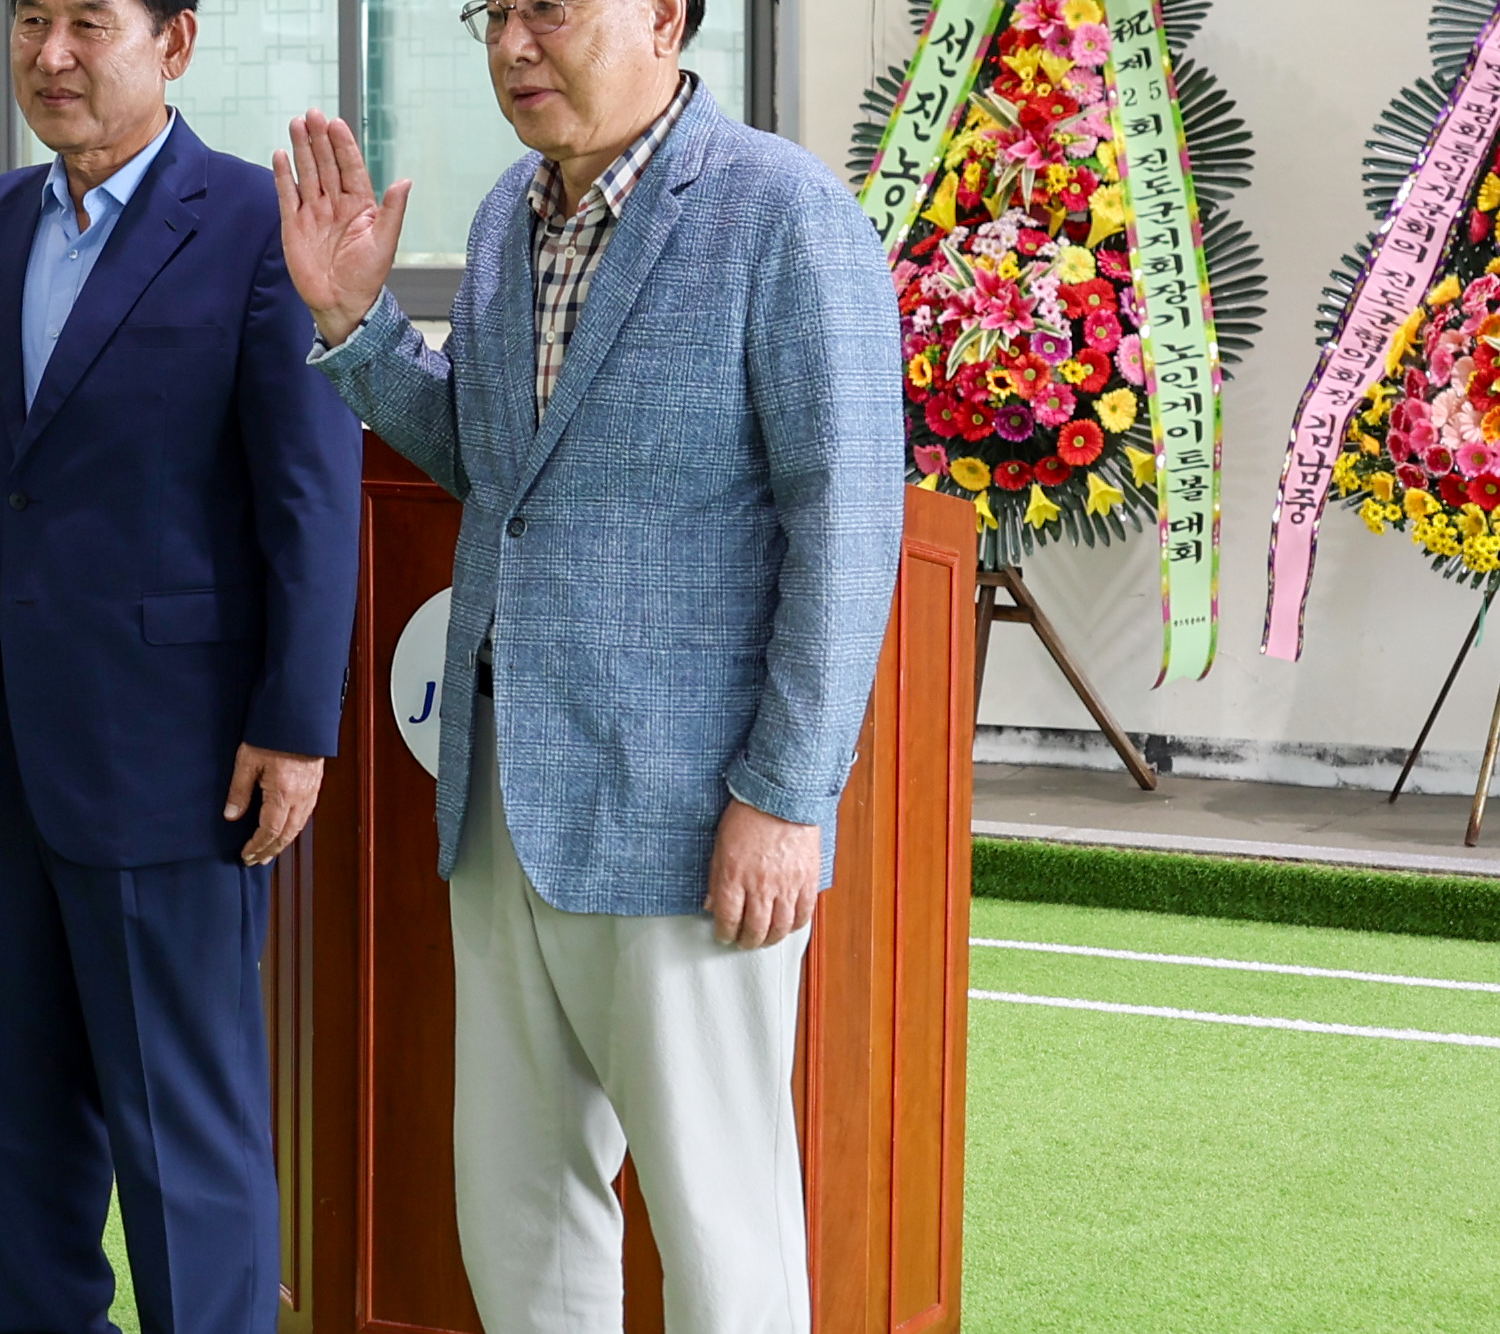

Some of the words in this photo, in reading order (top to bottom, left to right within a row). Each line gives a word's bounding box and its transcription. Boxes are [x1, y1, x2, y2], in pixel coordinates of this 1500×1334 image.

[1112, 10, 1155, 44] 祝
[1131, 148, 1198, 330] 진도군지회장기
[1154, 343, 1210, 503] 노인게이트볼
[1168, 512, 1204, 565] 대회
